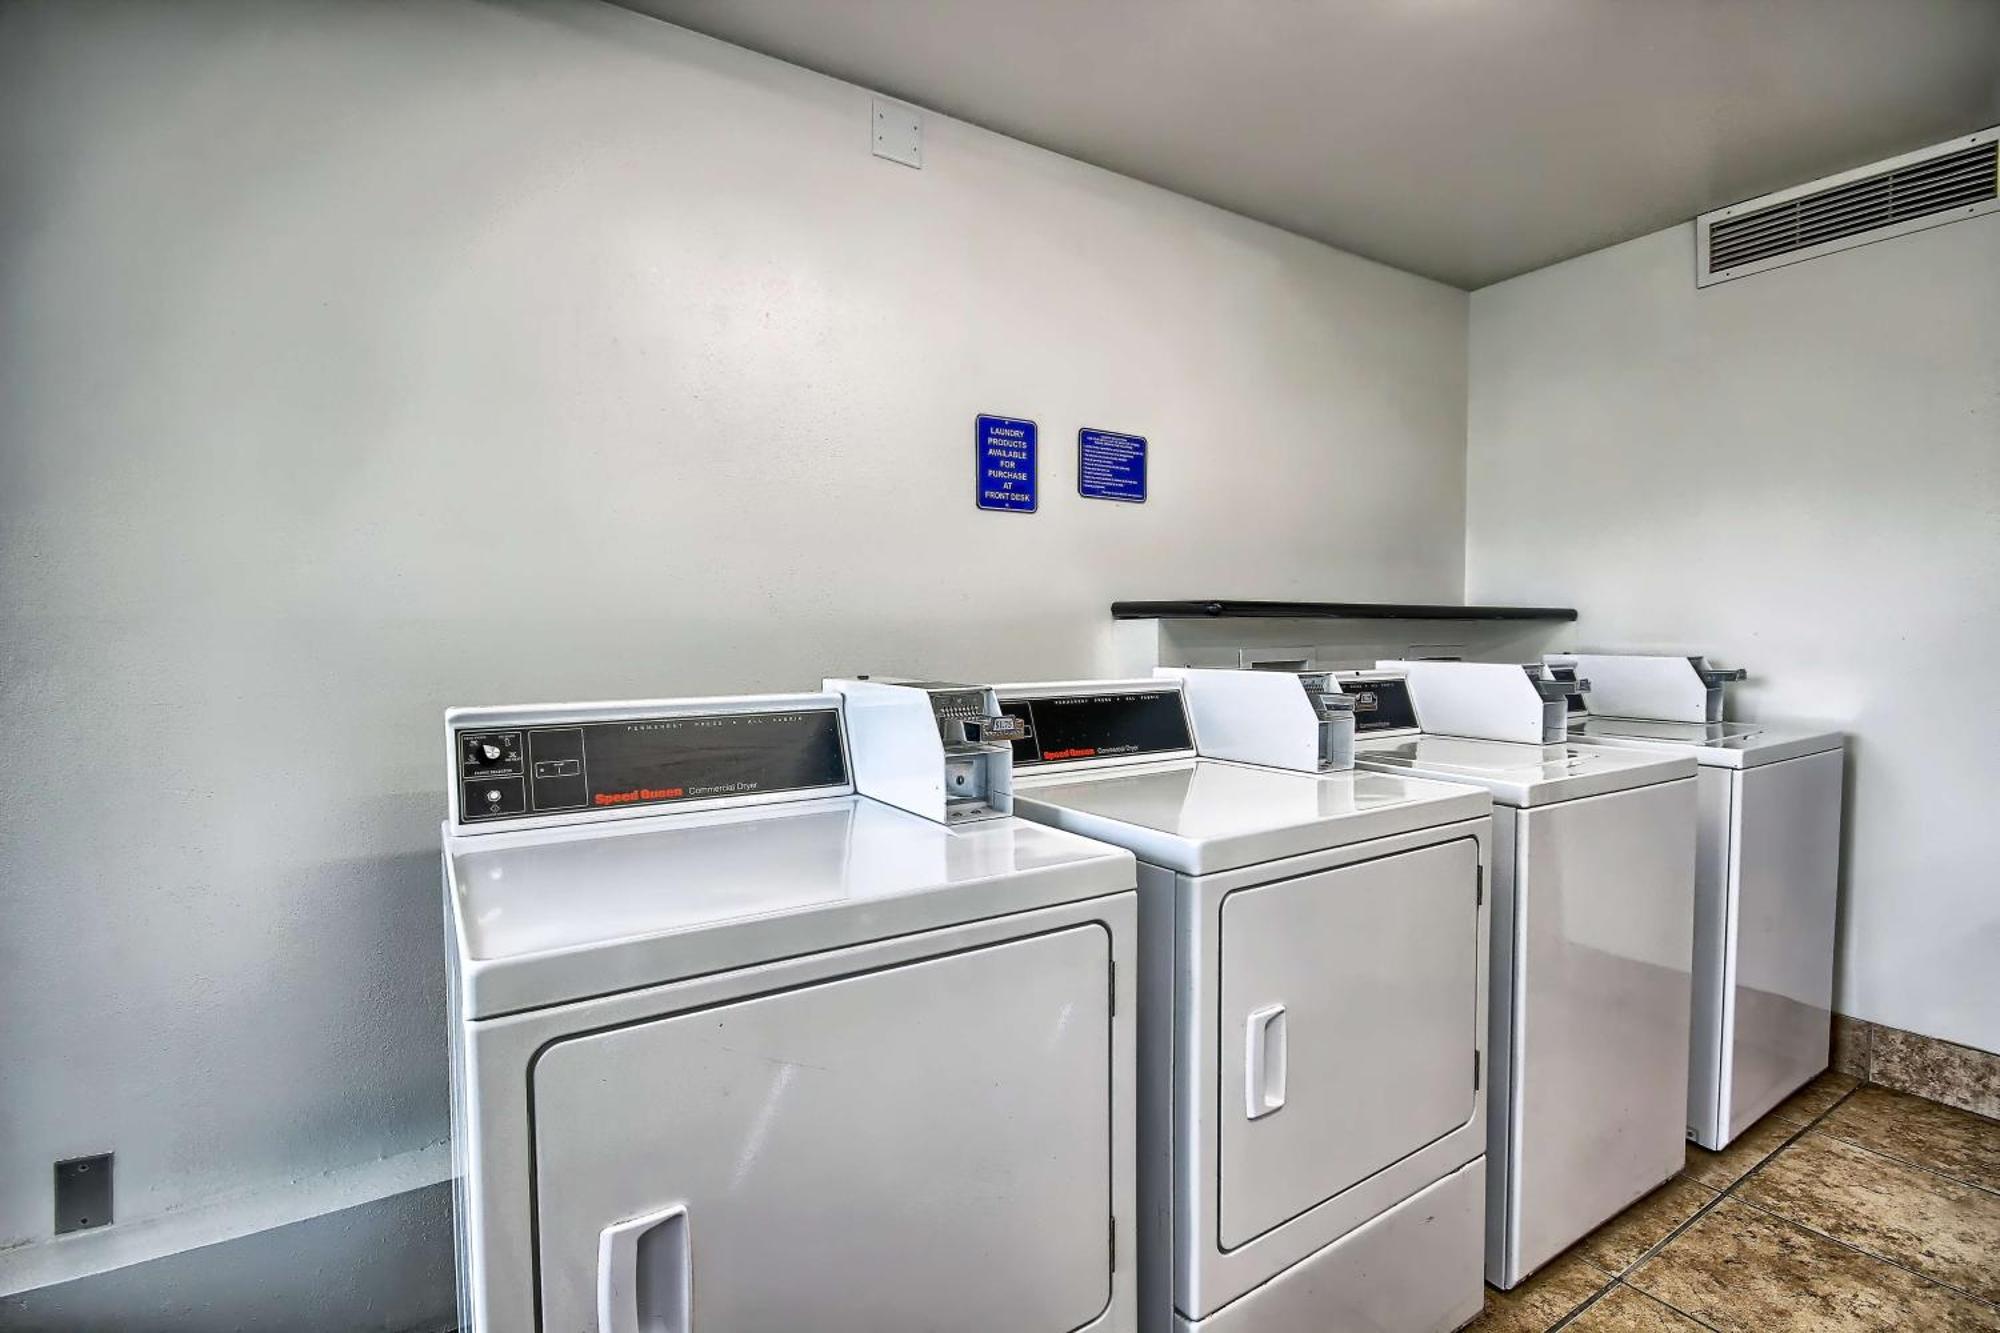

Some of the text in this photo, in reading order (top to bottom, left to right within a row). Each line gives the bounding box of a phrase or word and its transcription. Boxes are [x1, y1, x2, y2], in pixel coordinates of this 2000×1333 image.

[990, 427, 1025, 437] LAUNDRY
[987, 437, 1027, 448] PRODUCTS
[988, 448, 1027, 459] AVAILABLE
[1000, 460, 1015, 468] FOR
[988, 469, 1028, 480] PURCHASE
[1003, 482, 1013, 490] AT
[985, 491, 1030, 502] FRONT DESK
[1043, 749, 1069, 760] Speed
[1070, 748, 1095, 758] Queen
[594, 782, 758, 805] Speed Queen Commercial Dryer
